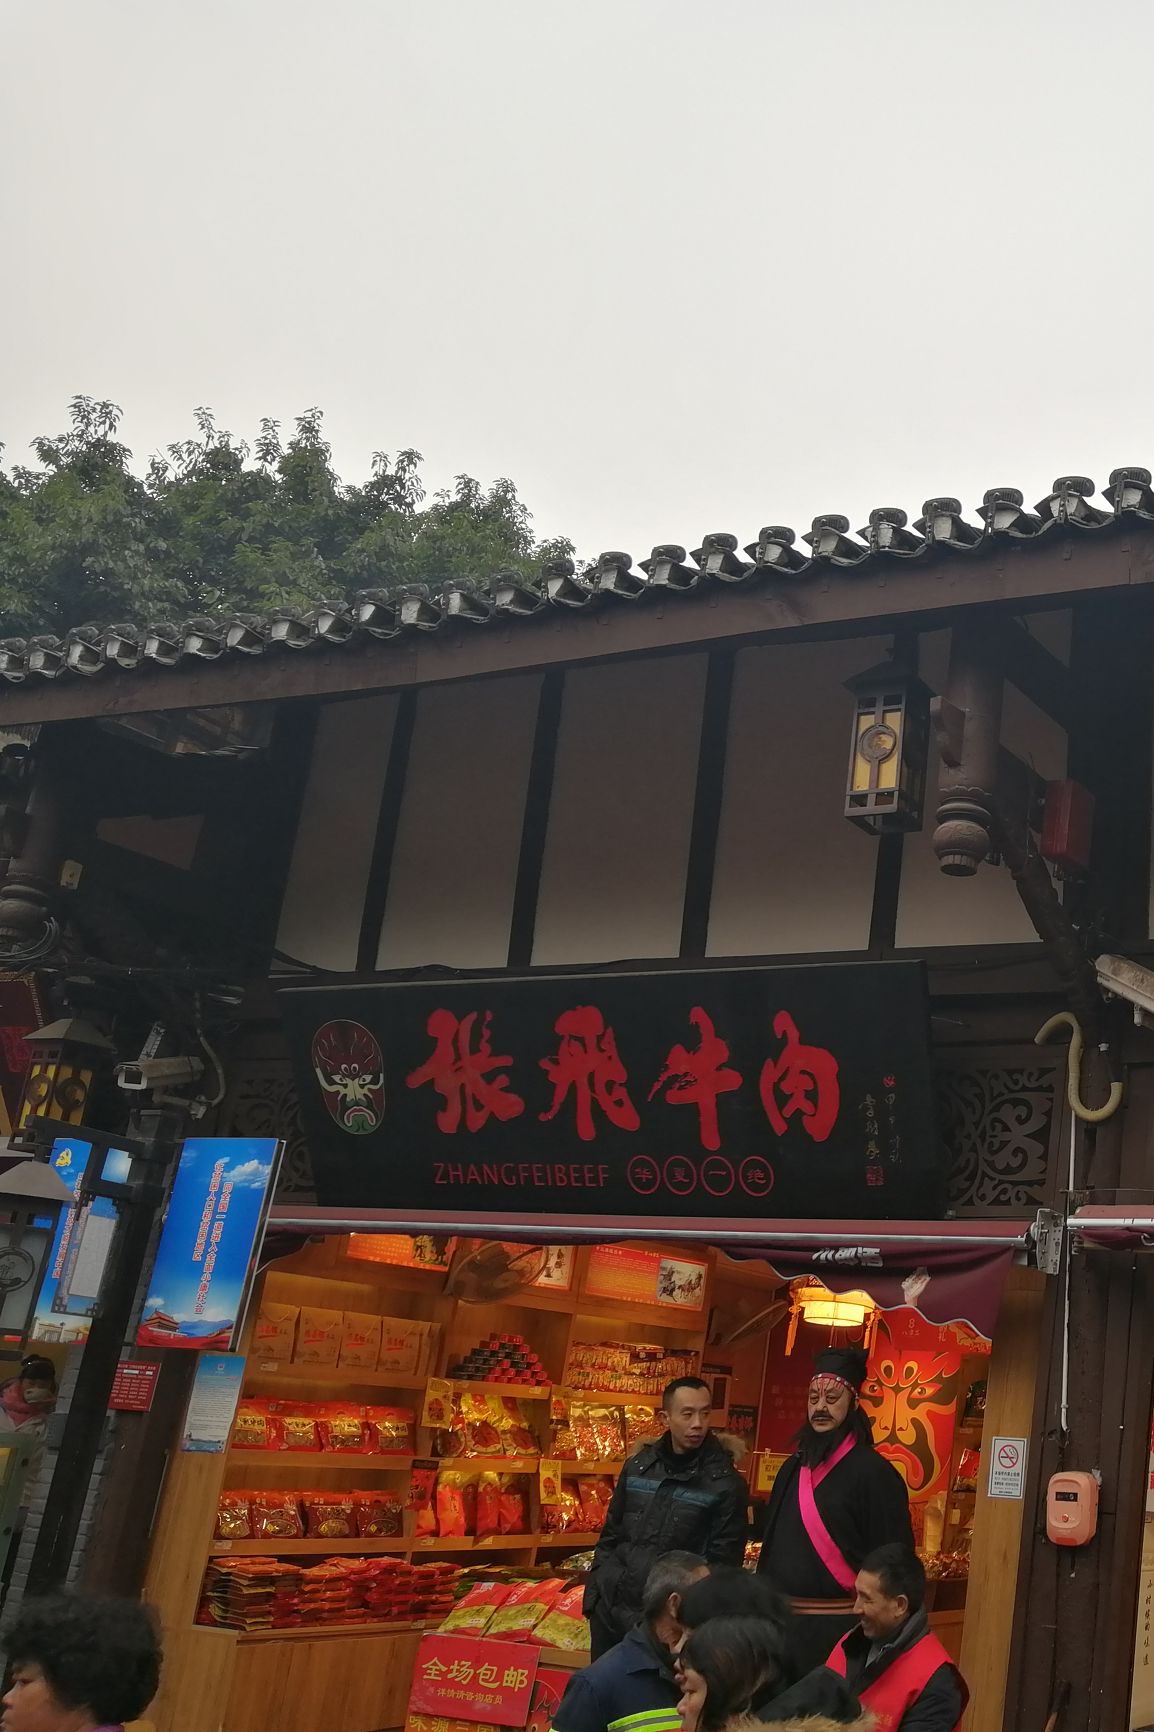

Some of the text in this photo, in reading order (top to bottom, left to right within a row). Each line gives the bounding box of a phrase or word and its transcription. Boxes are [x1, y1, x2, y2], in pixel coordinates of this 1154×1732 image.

[433, 1162, 610, 1188] ZHANGFEIBEEF
[422, 1656, 529, 1693] 全场包邮
[437, 1687, 504, 1706] 详情请咨询店员
